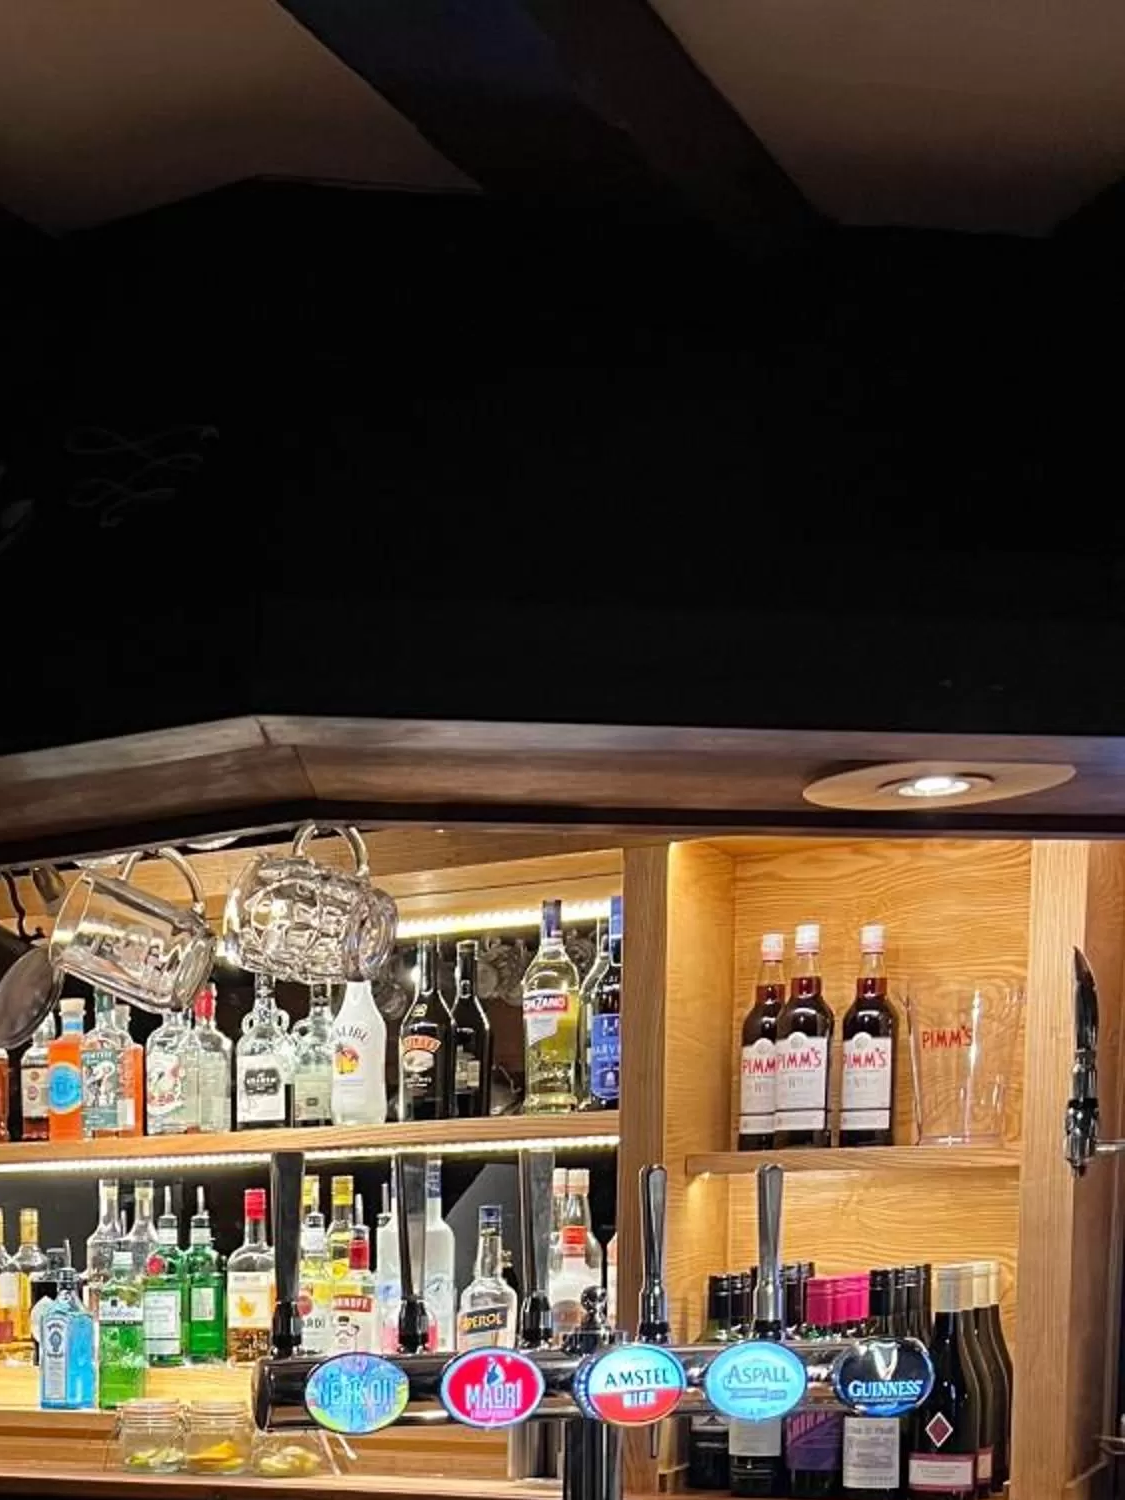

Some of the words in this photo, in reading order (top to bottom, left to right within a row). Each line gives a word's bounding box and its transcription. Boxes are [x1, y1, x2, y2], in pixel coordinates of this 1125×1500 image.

[922, 1026, 973, 1049] PIMM'S
[742, 1056, 776, 1074] PIMM
[778, 1047, 822, 1068] PIMM'S
[843, 1048, 887, 1070] PIMM'S
[604, 1368, 669, 1389] AMSTEL
[727, 1365, 791, 1384] ASPALL
[848, 1380, 923, 1398] GUINNESS
